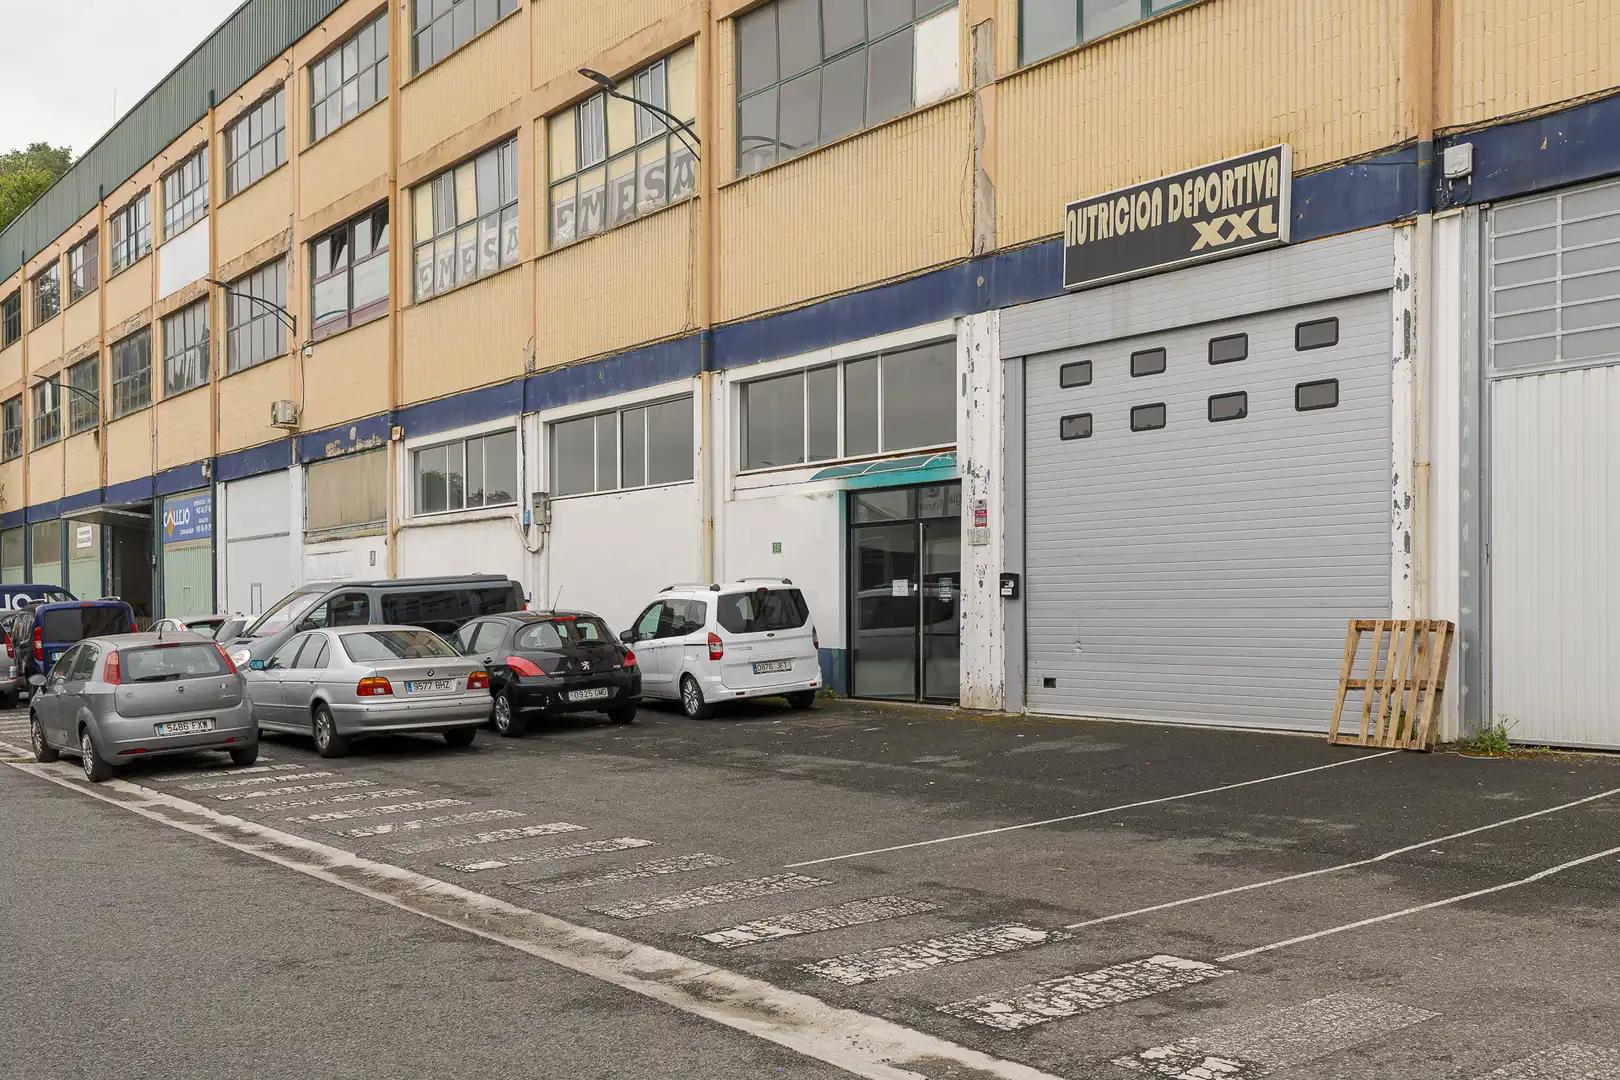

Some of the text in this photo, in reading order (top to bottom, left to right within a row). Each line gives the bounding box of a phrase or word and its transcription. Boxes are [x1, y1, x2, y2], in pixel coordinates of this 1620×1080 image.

[1066, 156, 1278, 248] NUTRICION DEPORTIVA
[1190, 204, 1277, 251] XXL
[413, 681, 450, 691] 9577 BHZ
[574, 690, 592, 699] 0925
[167, 722, 189, 733] 5486
